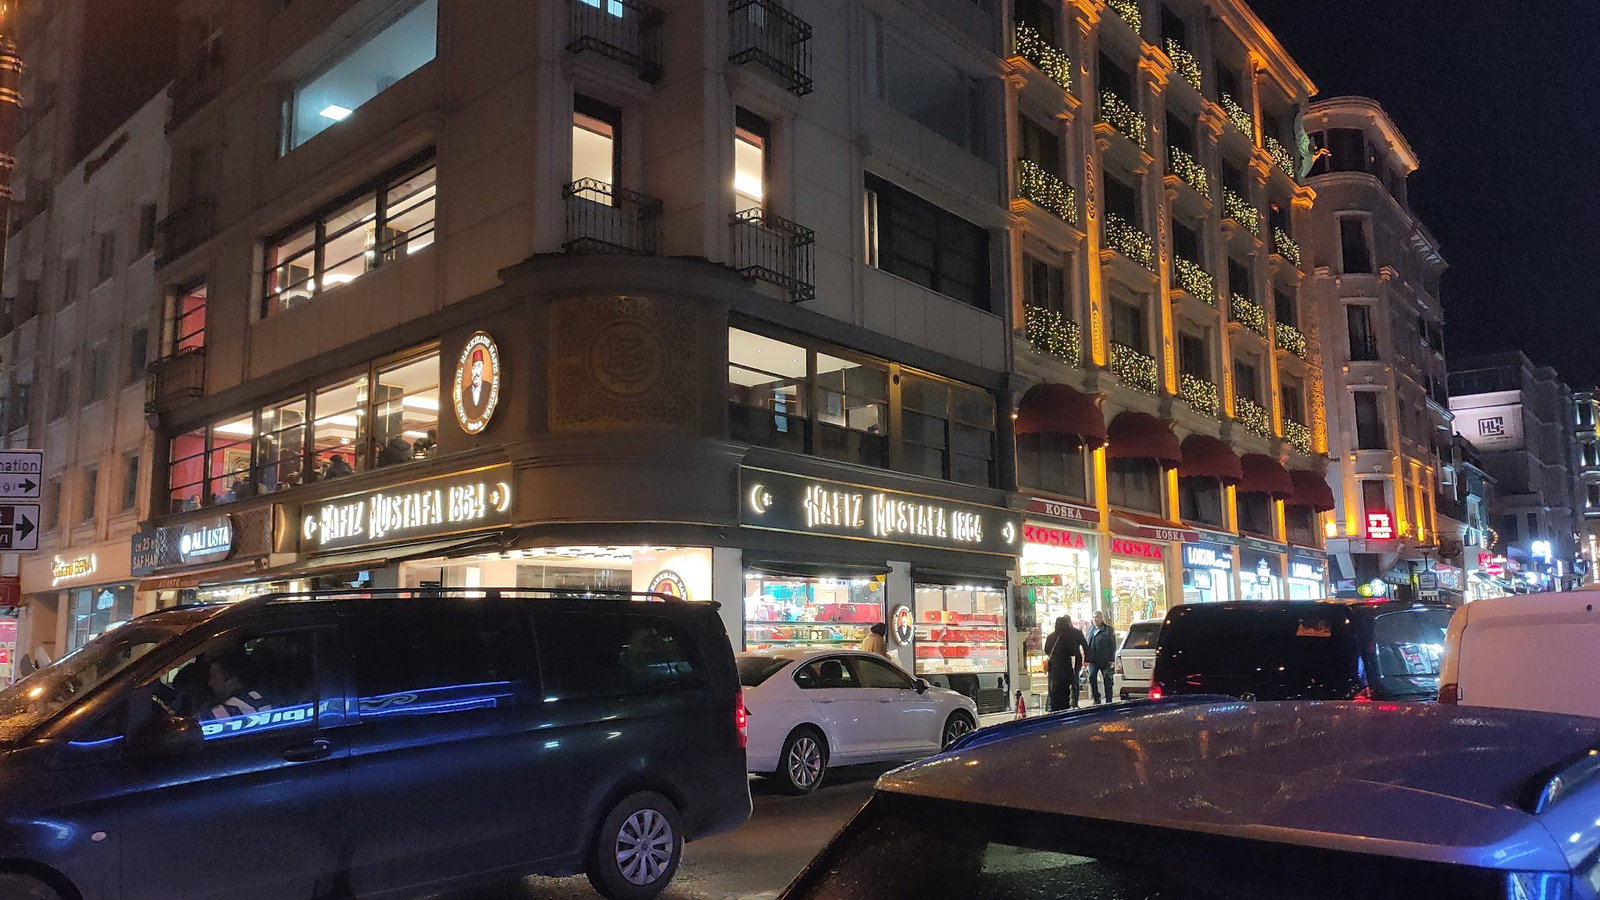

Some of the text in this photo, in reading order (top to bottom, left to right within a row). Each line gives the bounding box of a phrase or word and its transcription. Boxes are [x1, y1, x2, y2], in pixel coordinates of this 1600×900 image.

[319, 483, 485, 544] HAFIZ MUSTAFA 1864
[804, 485, 984, 542] HAFIZ MUSTAFA 1864
[1045, 503, 1083, 519] KOSKA
[207, 526, 229, 548] USTA
[1023, 525, 1086, 549] KOSKA
[1155, 529, 1186, 541] KOSKA
[1111, 538, 1163, 559] KOSKA
